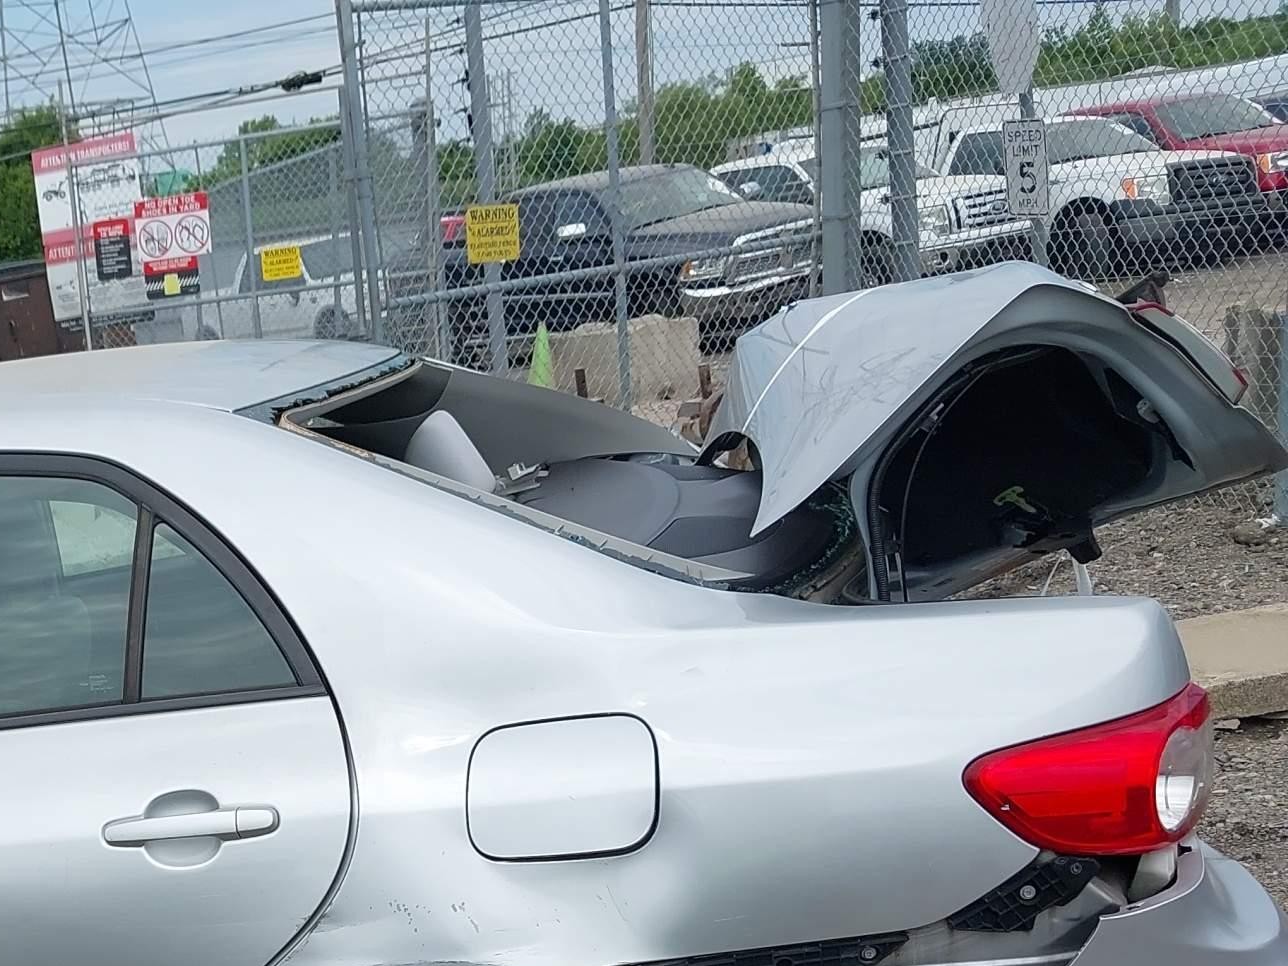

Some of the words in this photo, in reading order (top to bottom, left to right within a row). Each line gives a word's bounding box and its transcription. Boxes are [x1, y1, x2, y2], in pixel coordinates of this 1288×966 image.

[1008, 129, 1042, 142] SPEED
[1013, 144, 1040, 157] LIMIT
[40, 150, 76, 168] ATTENTIN
[1020, 162, 1037, 194] 5
[144, 200, 156, 209] NO
[157, 196, 179, 206] OPEN
[180, 193, 196, 203] TOE
[142, 206, 168, 218] SHOES
[169, 204, 178, 214] IN
[179, 201, 201, 212] YARD
[470, 207, 515, 221] WARNING
[264, 247, 297, 257] WARNING
